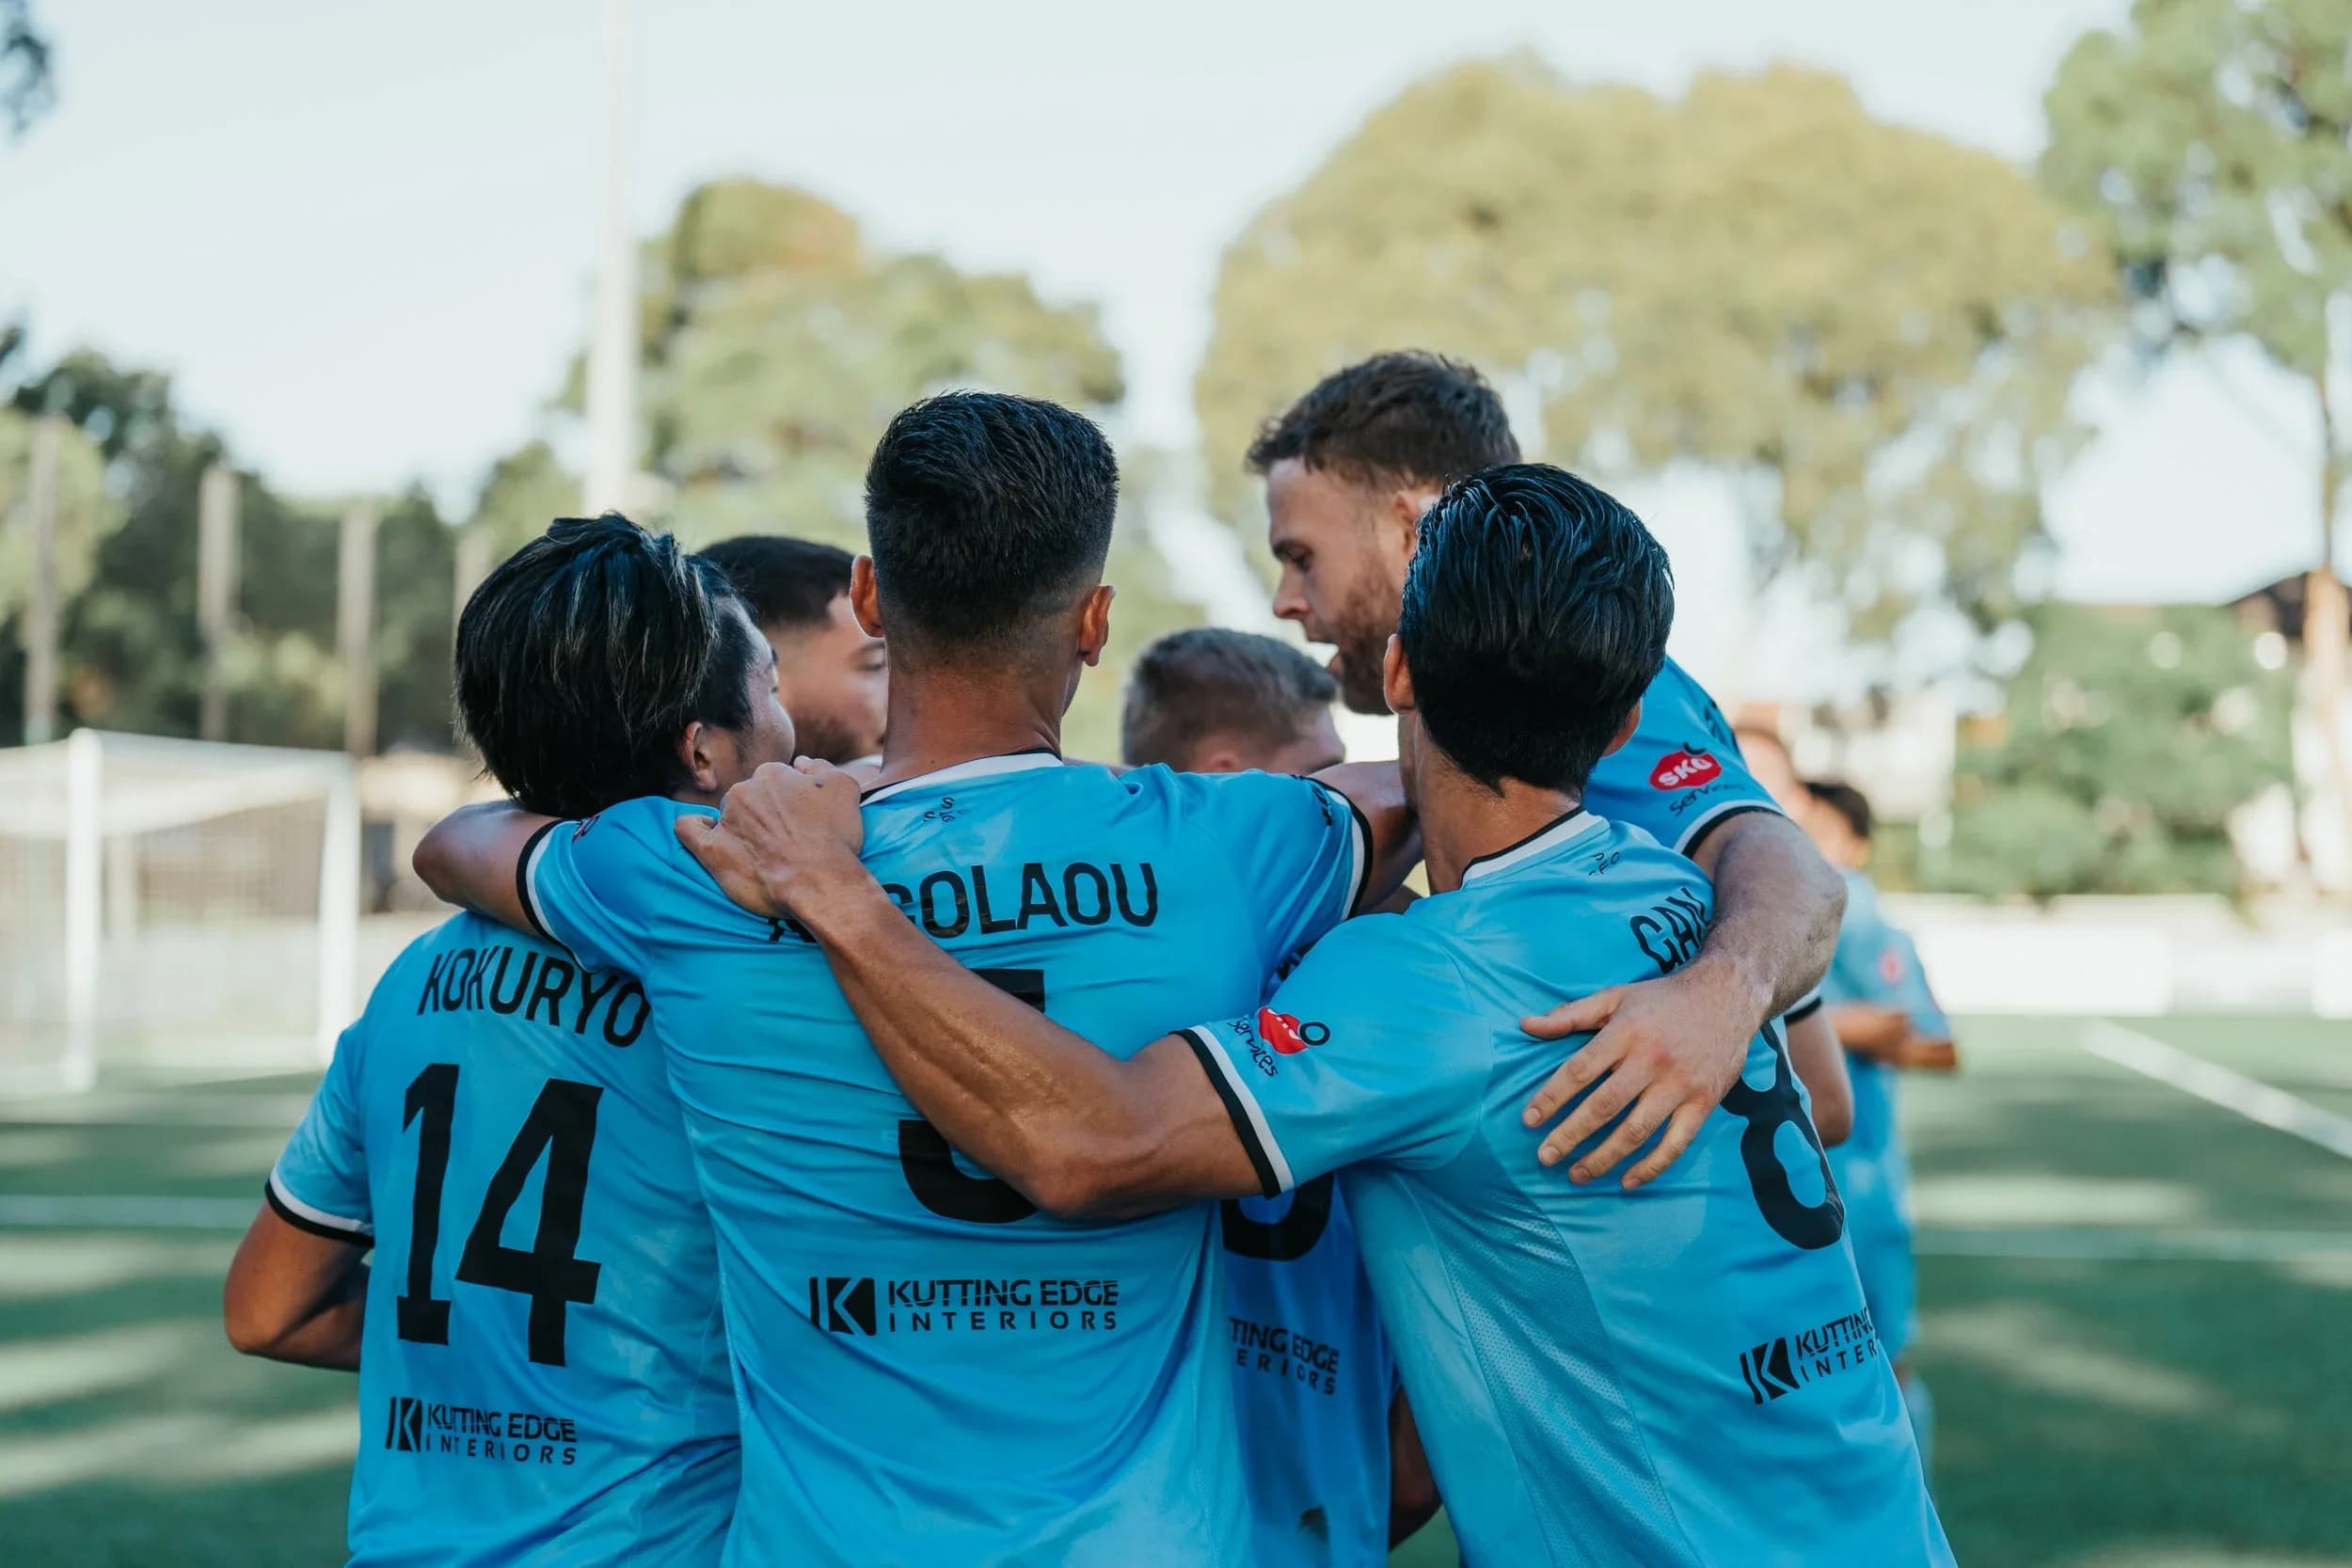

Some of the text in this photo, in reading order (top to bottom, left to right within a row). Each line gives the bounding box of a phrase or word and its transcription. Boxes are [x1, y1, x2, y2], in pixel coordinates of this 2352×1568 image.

[769, 862, 1158, 943] OLAOU
[417, 945, 651, 1048] KOKURYO
[397, 1063, 605, 1368] 14
[888, 1279, 1031, 1307] KUTTING
[1040, 1280, 1119, 1307] EDGE
[889, 1311, 1118, 1333] INTERIORS
[1292, 1332, 1340, 1373] EDGE
[427, 1403, 502, 1437] KUTTING
[508, 1413, 578, 1443] EDGE
[425, 1433, 577, 1465] INTERIORS
